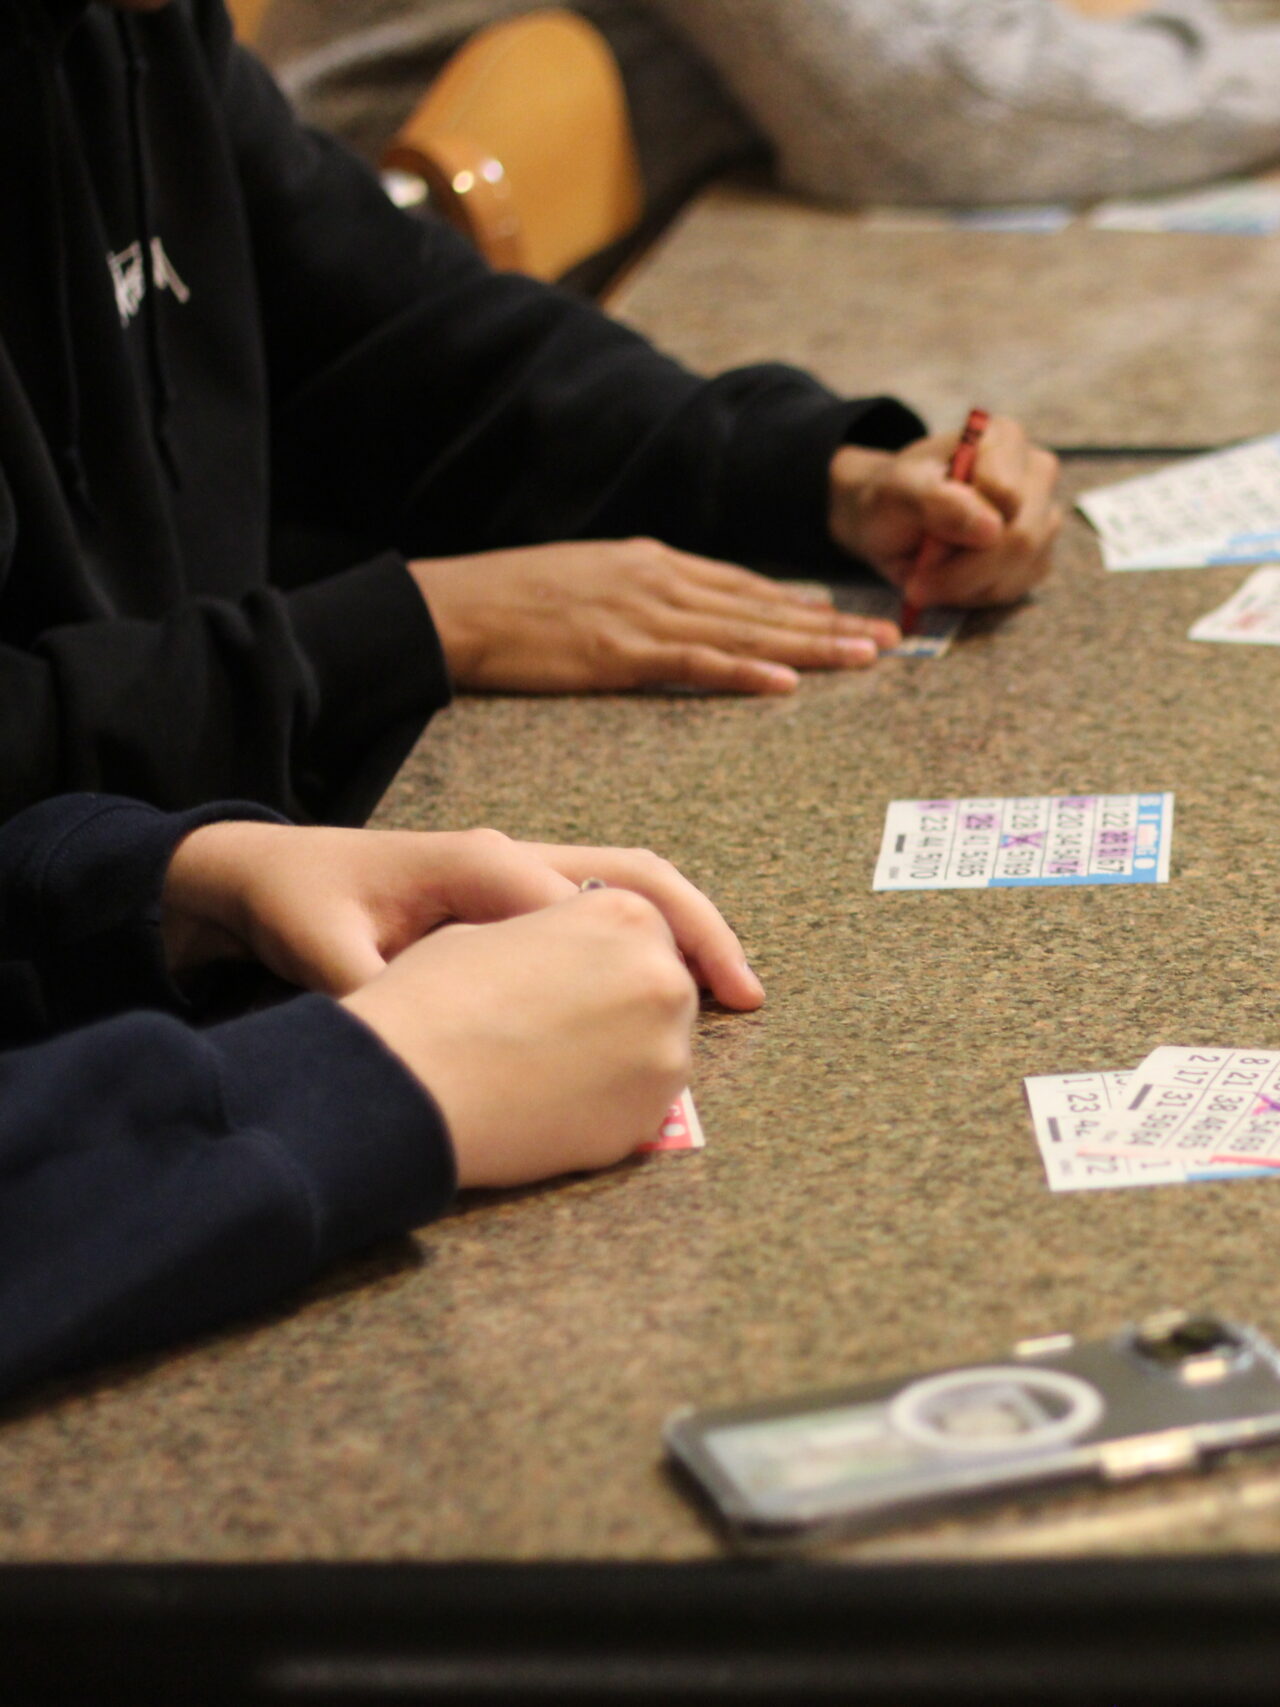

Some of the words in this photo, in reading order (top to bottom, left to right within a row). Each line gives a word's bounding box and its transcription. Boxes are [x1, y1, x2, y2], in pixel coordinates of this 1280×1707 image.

[919, 815, 948, 831] 23
[1011, 814, 1038, 829] 28
[1056, 813, 1083, 828] 20
[1102, 812, 1129, 827] 22
[1054, 832, 1082, 845] 34
[909, 865, 939, 879] 70
[1003, 862, 1032, 875] 69
[1049, 861, 1078, 874] 74
[1096, 859, 1124, 872] 67
[1187, 1054, 1220, 1062] 2
[1173, 1069, 1208, 1084] 17
[1221, 1071, 1259, 1085] 21
[1066, 1092, 1103, 1113] 23
[1155, 1090, 1193, 1107] 31
[1206, 1094, 1244, 1111] 38
[1190, 1116, 1227, 1131] 46
[1248, 1118, 1280, 1134] 54
